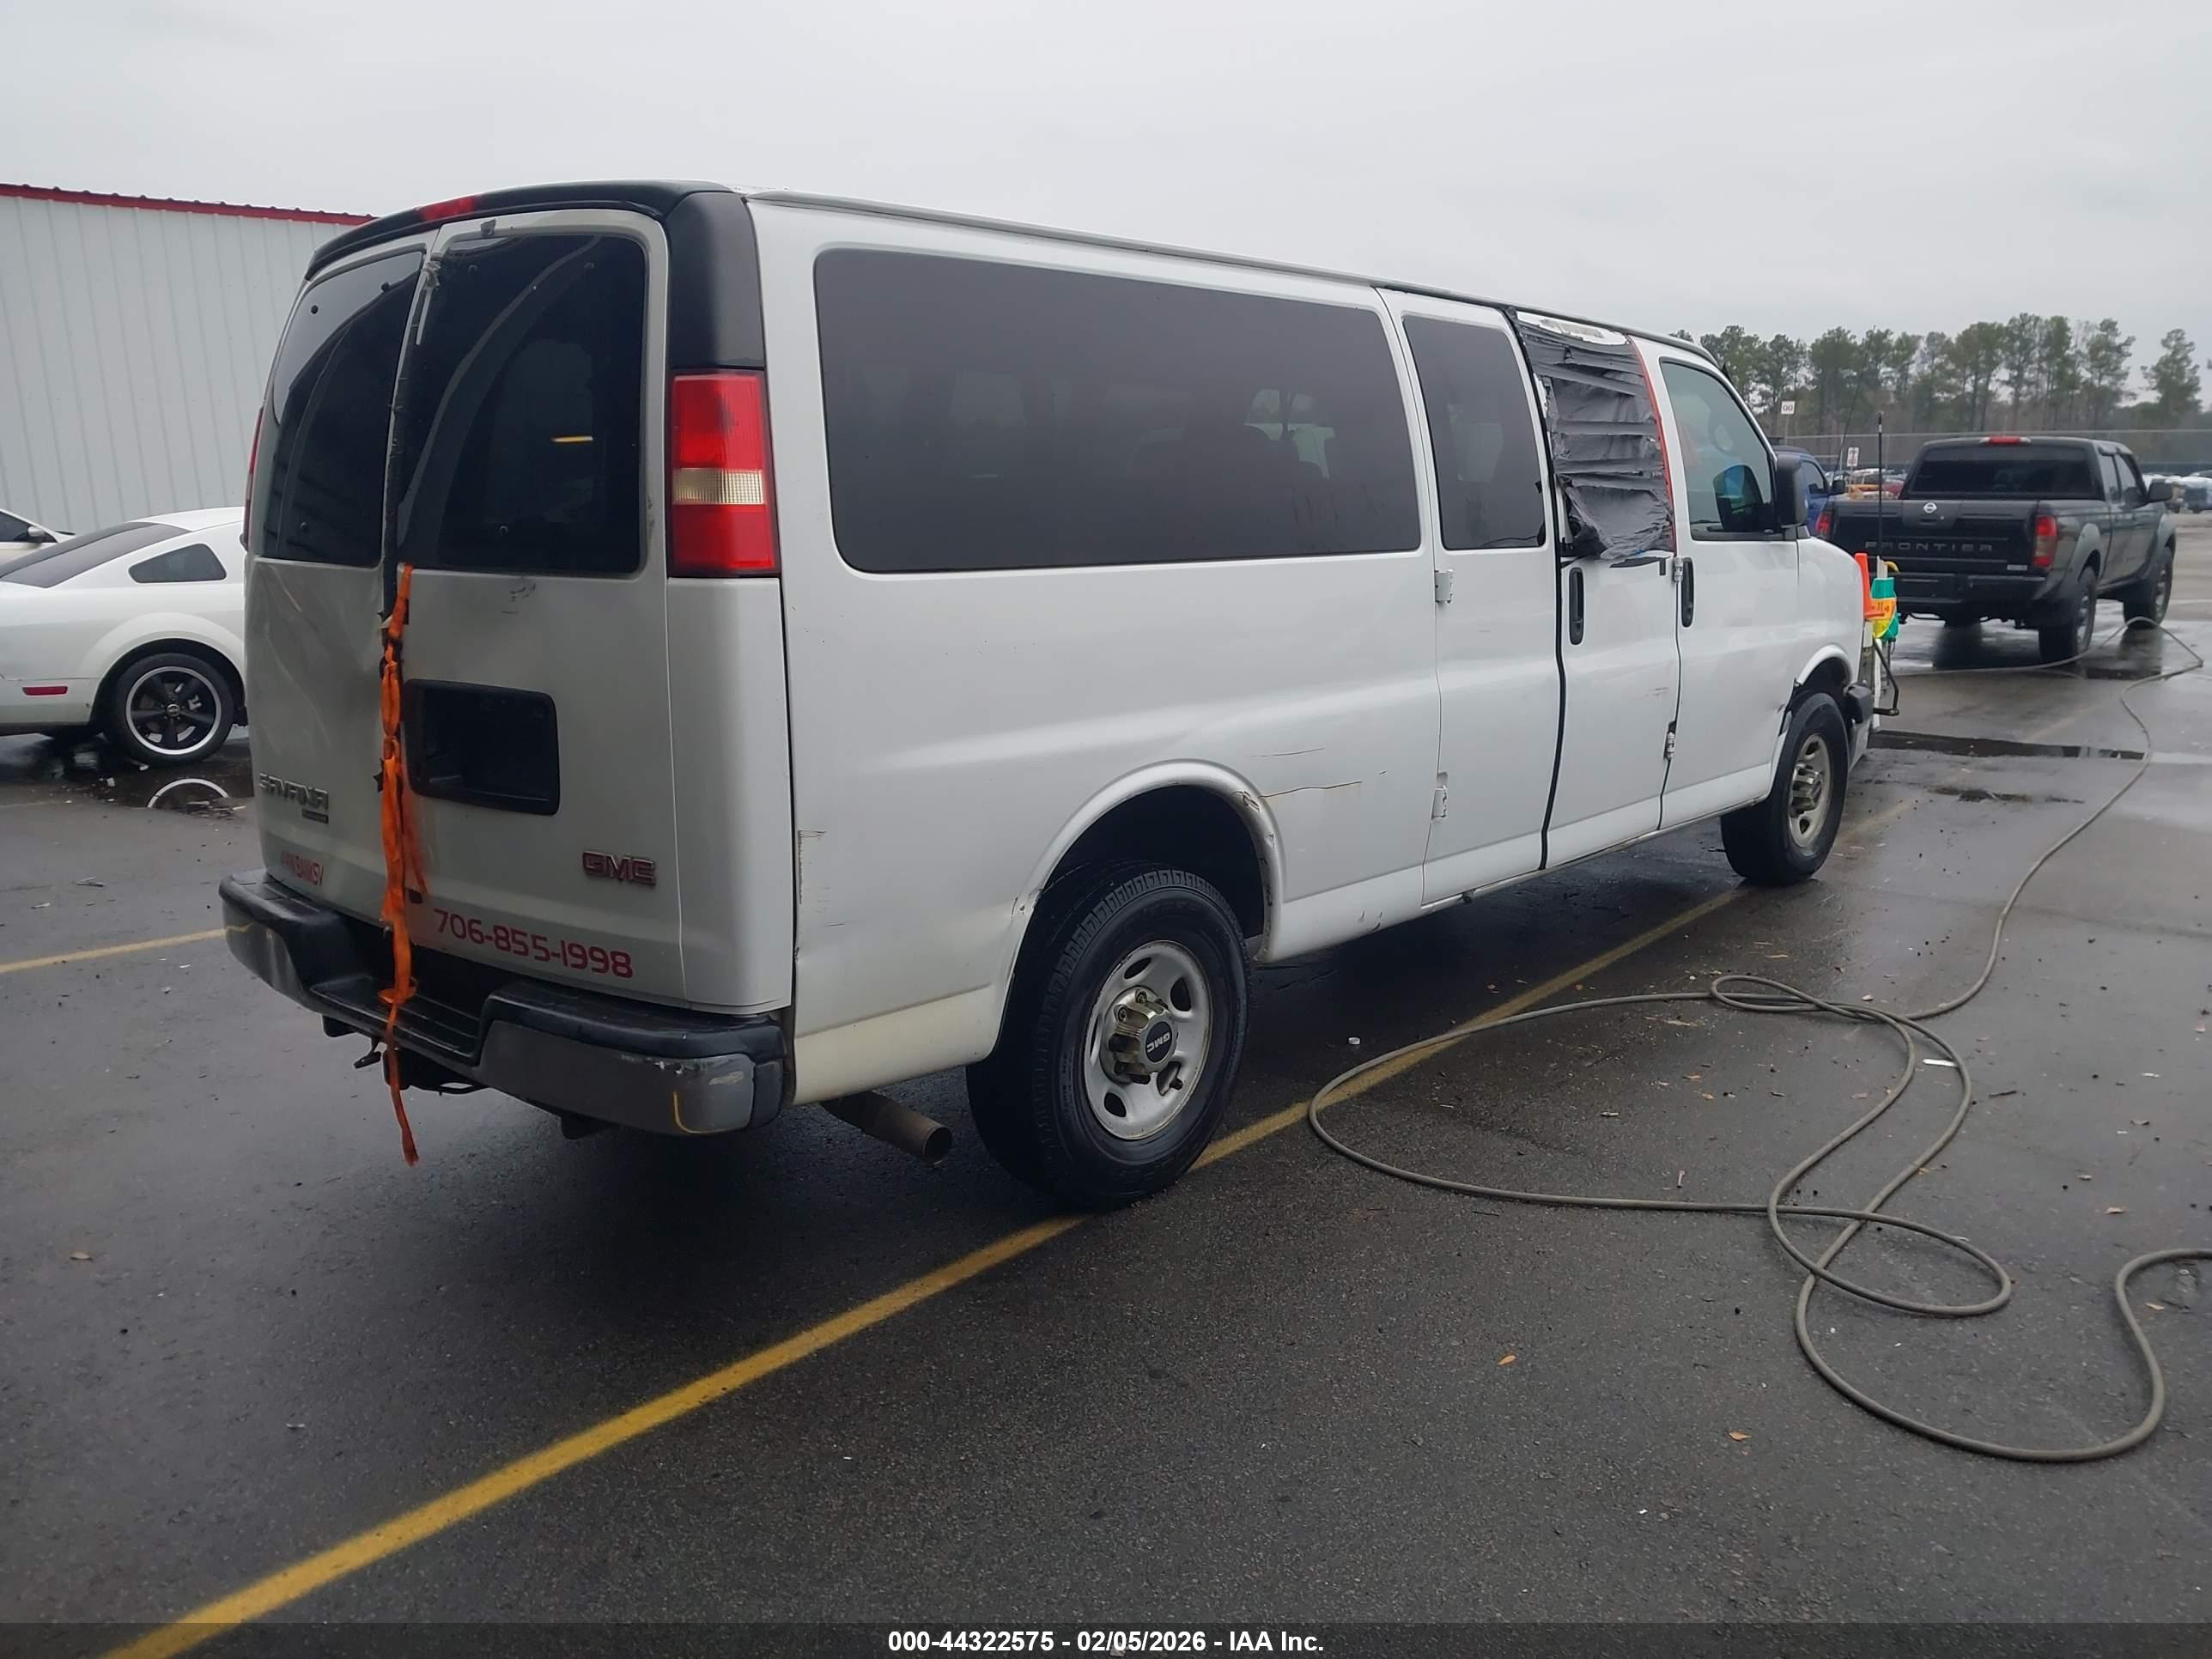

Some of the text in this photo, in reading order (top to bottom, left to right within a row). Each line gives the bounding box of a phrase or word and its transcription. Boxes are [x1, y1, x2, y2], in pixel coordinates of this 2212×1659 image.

[1864, 541, 1993, 552] FRONTIER
[582, 849, 657, 887] GMC
[434, 908, 634, 979] 706-855-1998
[1146, 1032, 1170, 1054] GMC
